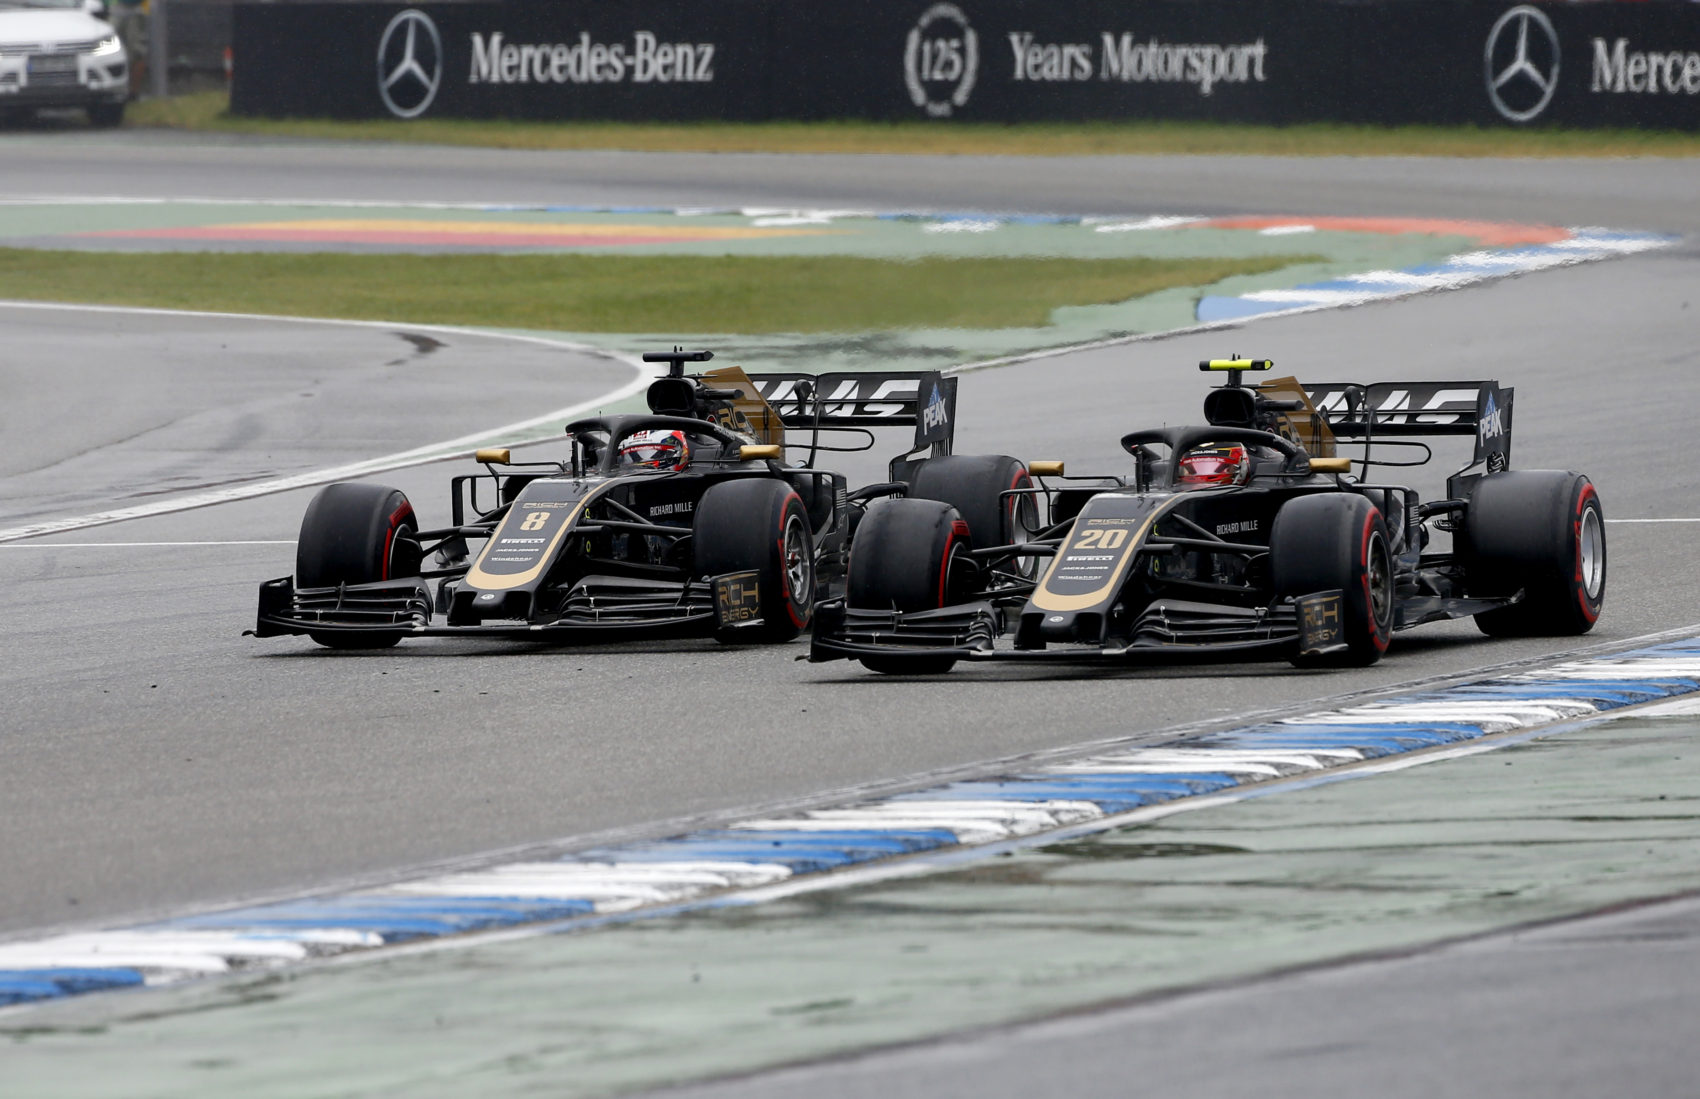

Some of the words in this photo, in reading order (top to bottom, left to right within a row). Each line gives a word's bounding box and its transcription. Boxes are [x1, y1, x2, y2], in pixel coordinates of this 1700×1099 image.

[469, 31, 714, 83] Mercedes-Benz
[921, 38, 963, 81] 125
[1008, 31, 1092, 81] Years
[1100, 31, 1266, 96] Motorsport
[1591, 37, 1700, 94] Merce
[923, 397, 948, 436] PEAK
[1480, 408, 1503, 447] PEAK
[520, 511, 551, 531] 8
[649, 504, 673, 516] RICHARD
[674, 501, 693, 513] MILLE
[1216, 524, 1240, 535] RICHARD
[1240, 520, 1258, 530] MILLE
[1074, 529, 1128, 549] 20
